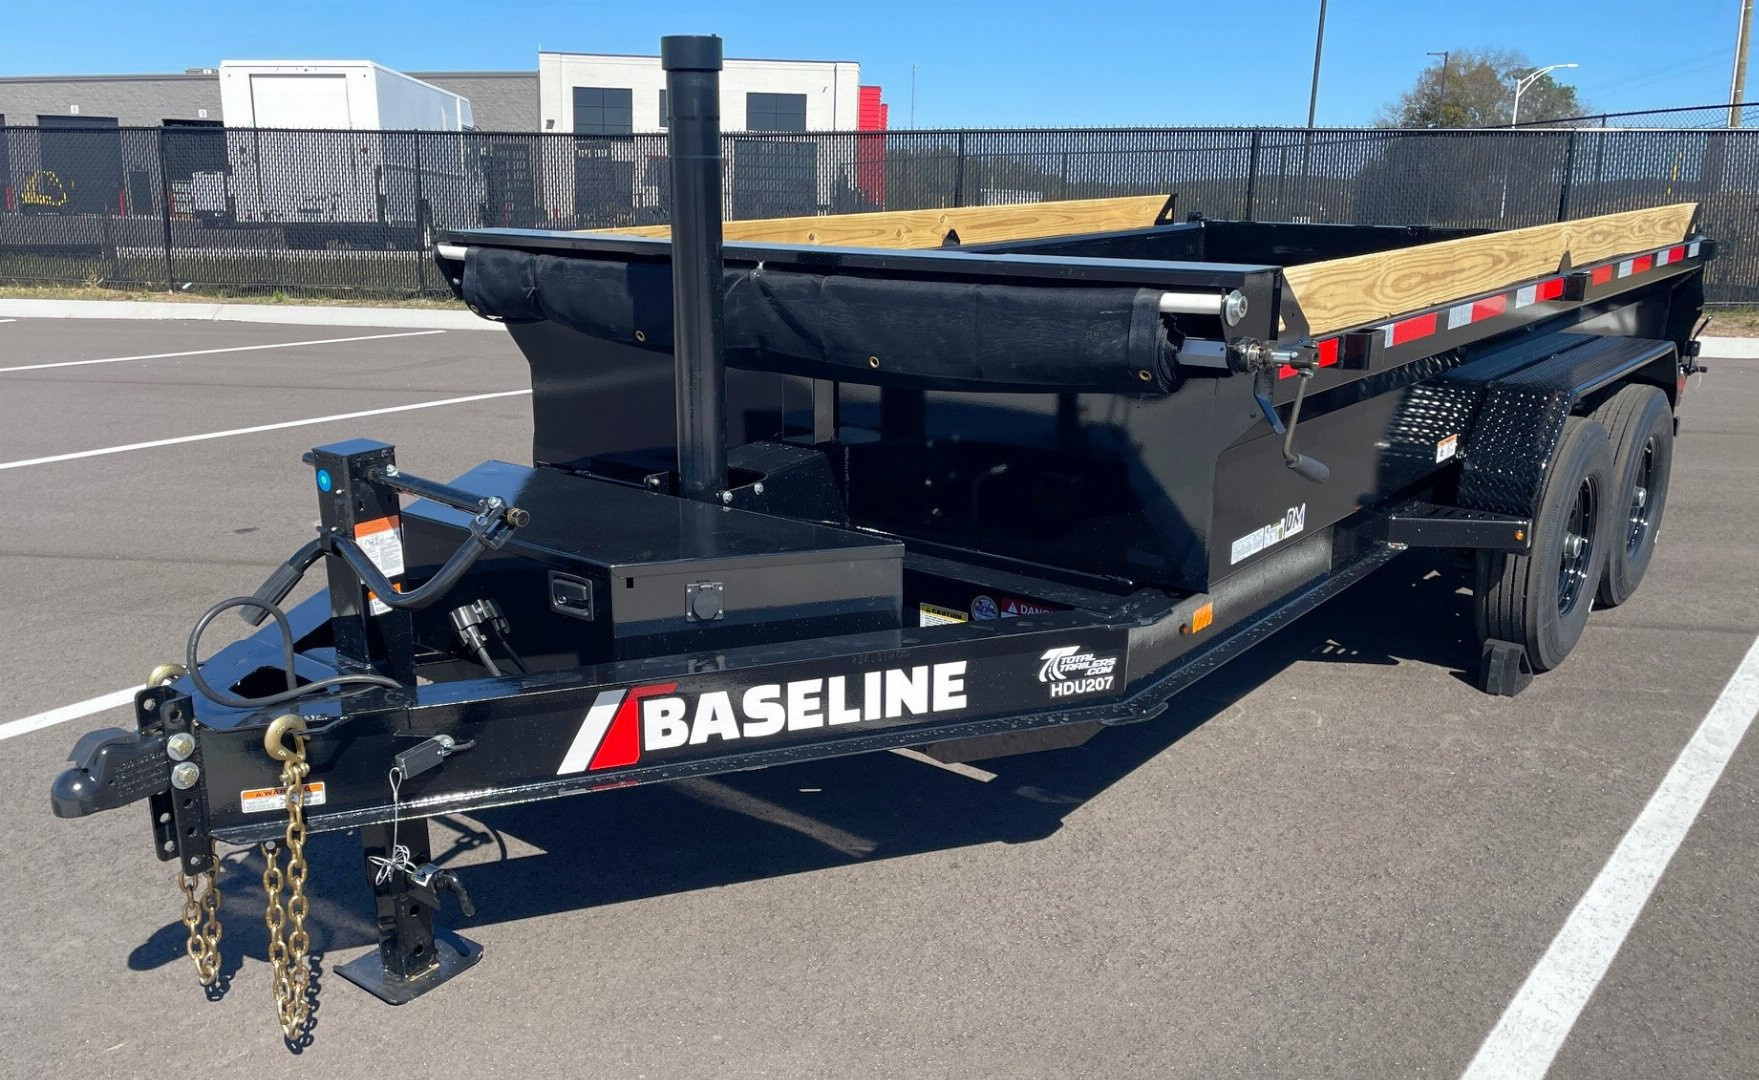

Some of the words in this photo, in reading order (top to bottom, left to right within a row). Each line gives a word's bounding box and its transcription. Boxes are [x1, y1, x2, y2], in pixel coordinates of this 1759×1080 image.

[932, 608, 962, 620] CAUTION
[1020, 604, 1051, 615] DAN
[1061, 653, 1096, 664] TOTAL
[1060, 658, 1117, 672] TRAILERS
[1084, 666, 1113, 676] .COM
[1051, 676, 1114, 697] HDU207
[643, 660, 968, 751] BASELINE
[264, 785, 311, 796] WARG
